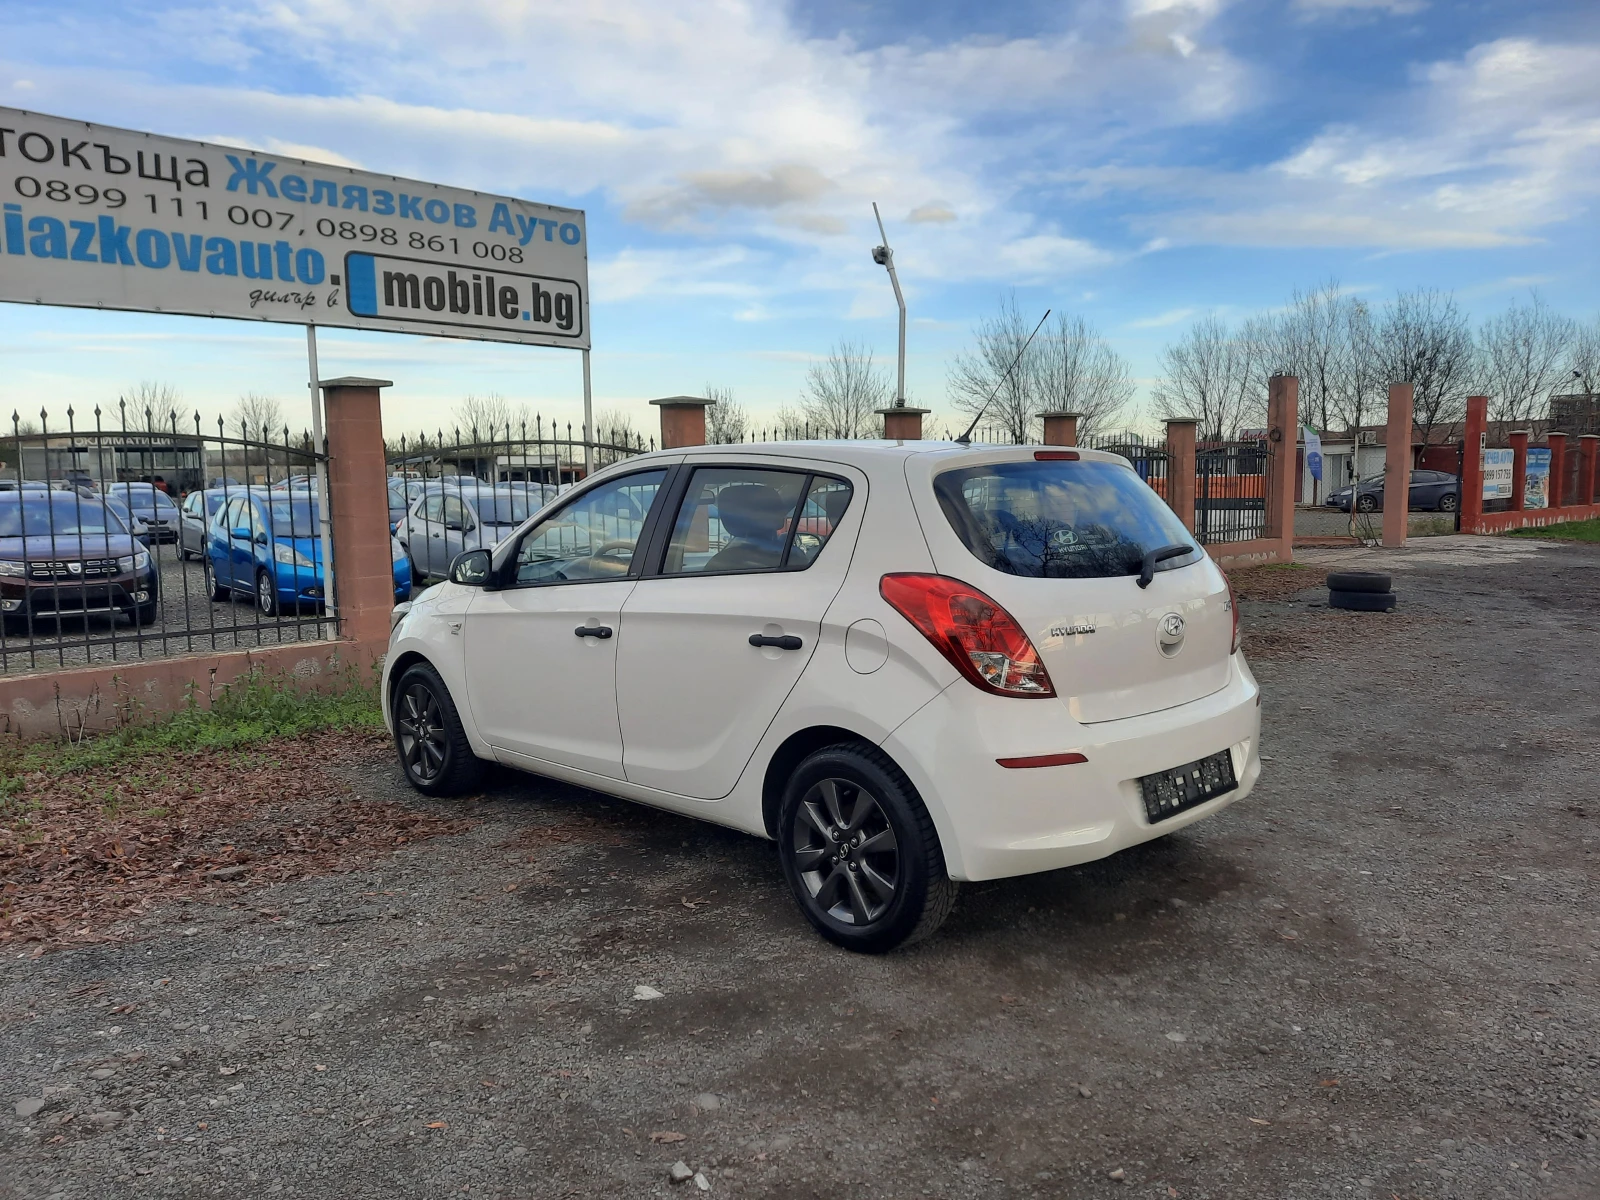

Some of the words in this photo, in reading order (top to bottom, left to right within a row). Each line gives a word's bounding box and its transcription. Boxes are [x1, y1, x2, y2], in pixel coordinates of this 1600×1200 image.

[14, 175, 128, 209] 0899
[145, 194, 209, 221] 111
[316, 217, 399, 246] 0898
[408, 230, 460, 255] 861
[472, 241, 524, 264] 008
[225, 154, 478, 229] Желязков
[488, 202, 581, 247] Ауто
[383, 270, 574, 331] mobile.bg
[1058, 544, 1089, 554] HYUNDAI
[1050, 623, 1096, 638] HYUNDAI
